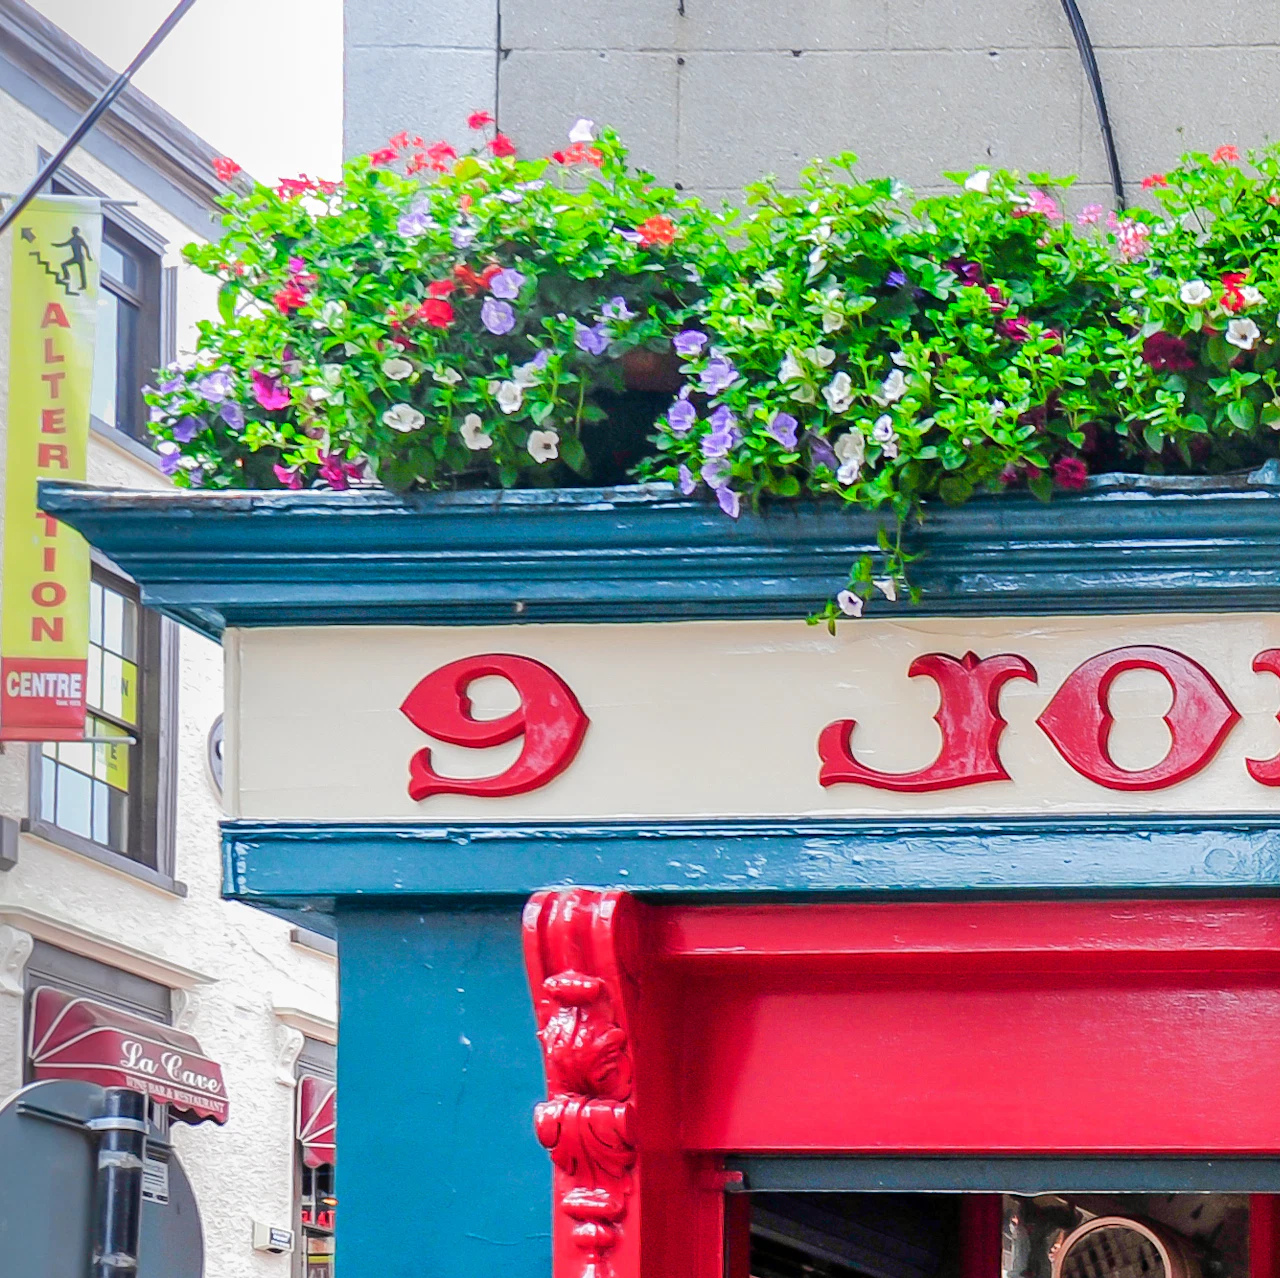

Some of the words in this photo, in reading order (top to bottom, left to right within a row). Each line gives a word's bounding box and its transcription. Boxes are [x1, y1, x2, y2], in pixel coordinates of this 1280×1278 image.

[31, 302, 71, 642] ALTERTION
[6, 670, 82, 698] CENTRE
[399, 653, 590, 802] 9
[120, 1040, 159, 1074] La
[161, 1052, 222, 1092] Cave
